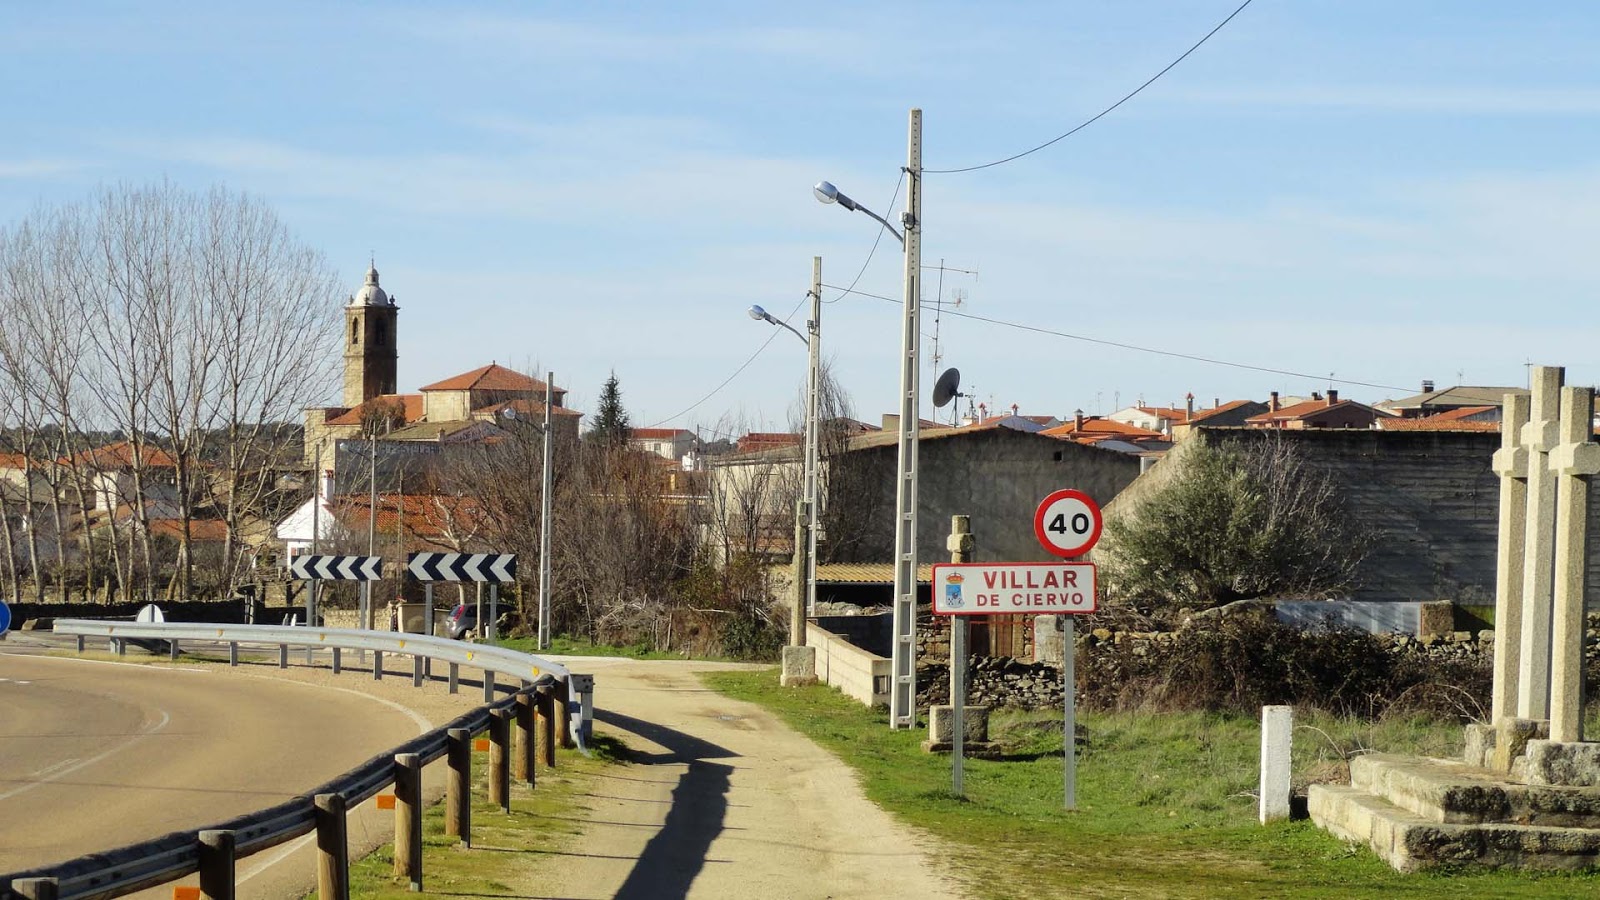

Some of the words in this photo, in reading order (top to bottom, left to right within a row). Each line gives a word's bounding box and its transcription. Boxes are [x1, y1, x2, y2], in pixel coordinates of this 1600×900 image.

[1048, 513, 1089, 534] 40
[983, 570, 1077, 589] VILLAR
[977, 594, 1000, 607] DE
[1012, 593, 1083, 606] CIERVO
